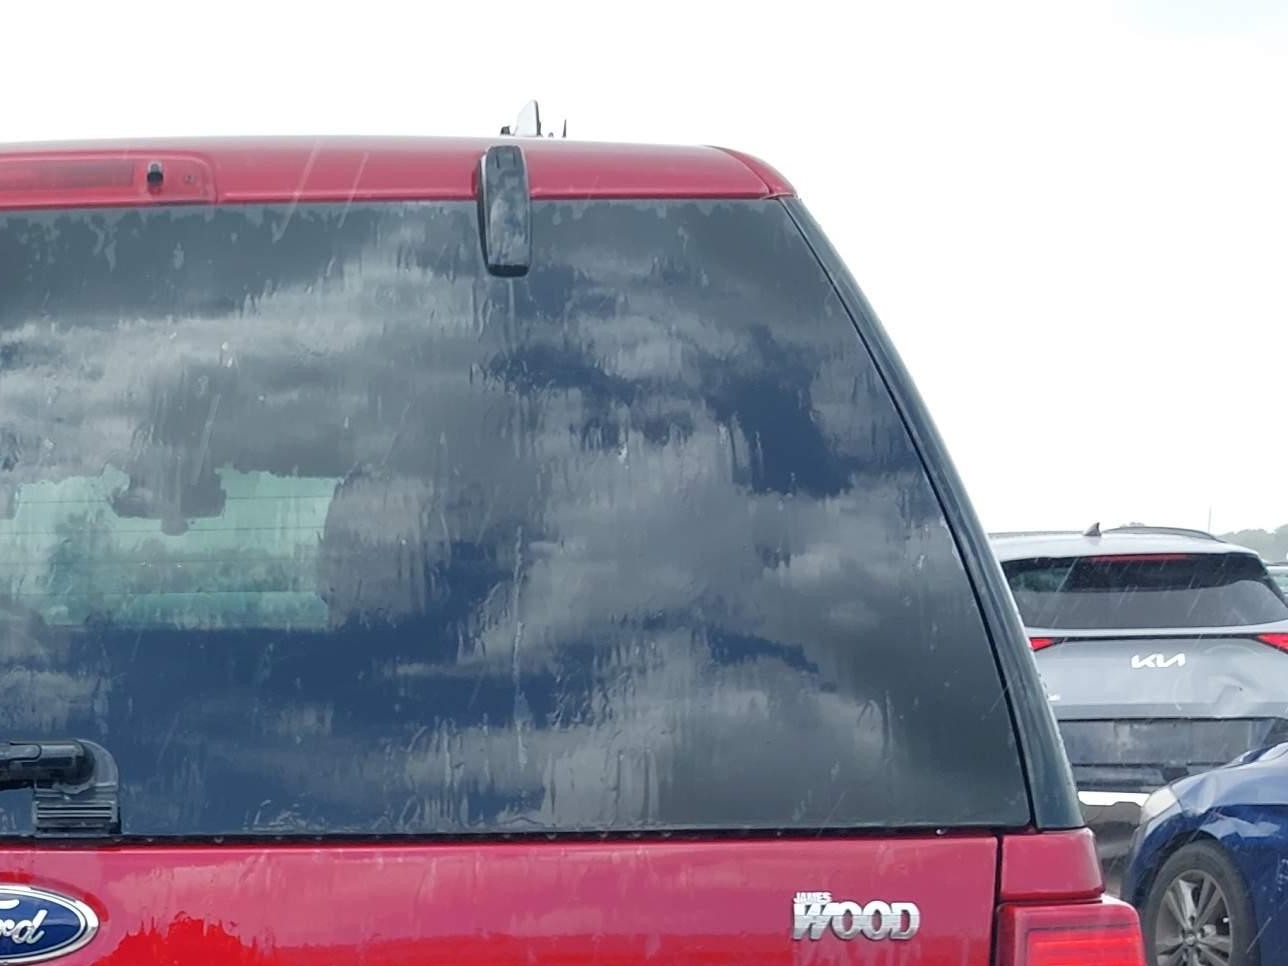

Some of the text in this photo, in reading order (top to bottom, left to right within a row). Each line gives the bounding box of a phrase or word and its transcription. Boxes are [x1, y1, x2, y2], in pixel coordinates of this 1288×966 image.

[1131, 653, 1186, 668] KIA
[793, 891, 832, 903] JAMES
[792, 900, 921, 940] WOOD
